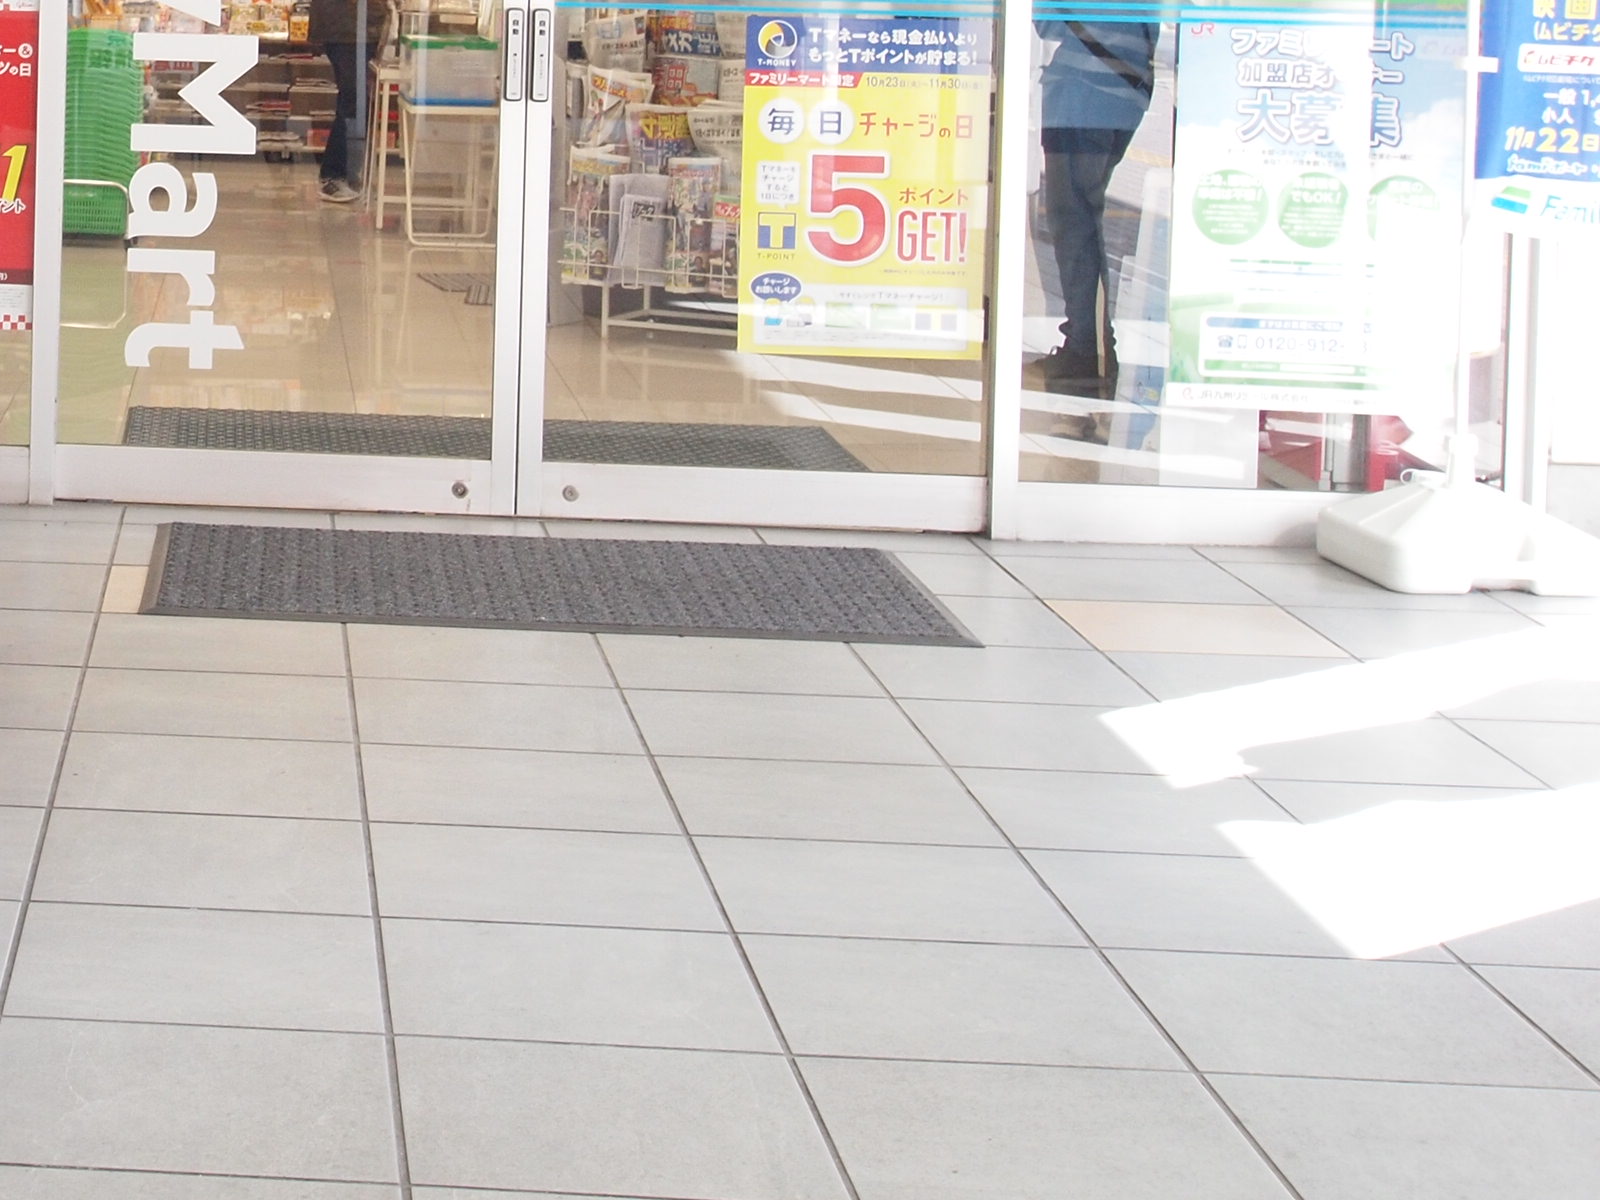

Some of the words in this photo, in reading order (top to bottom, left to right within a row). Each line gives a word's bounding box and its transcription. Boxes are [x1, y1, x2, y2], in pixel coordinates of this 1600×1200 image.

[808, 28, 977, 46] Tマネーなら現金払いより
[1191, 22, 1215, 36] JR
[758, 59, 796, 67] T-MONEY
[808, 48, 977, 65] もっとTポイントが貯まる!
[749, 72, 854, 87] ファミリーマート限定
[768, 108, 841, 136] 毎日
[859, 112, 974, 140] チャージの日
[1541, 106, 1574, 125] 小人
[761, 174, 793, 183] チャージ
[767, 184, 789, 192] すると
[899, 187, 969, 206] ポイント
[761, 193, 795, 201] 1日につき
[809, 154, 886, 263] 5
[898, 210, 967, 262] GET!
